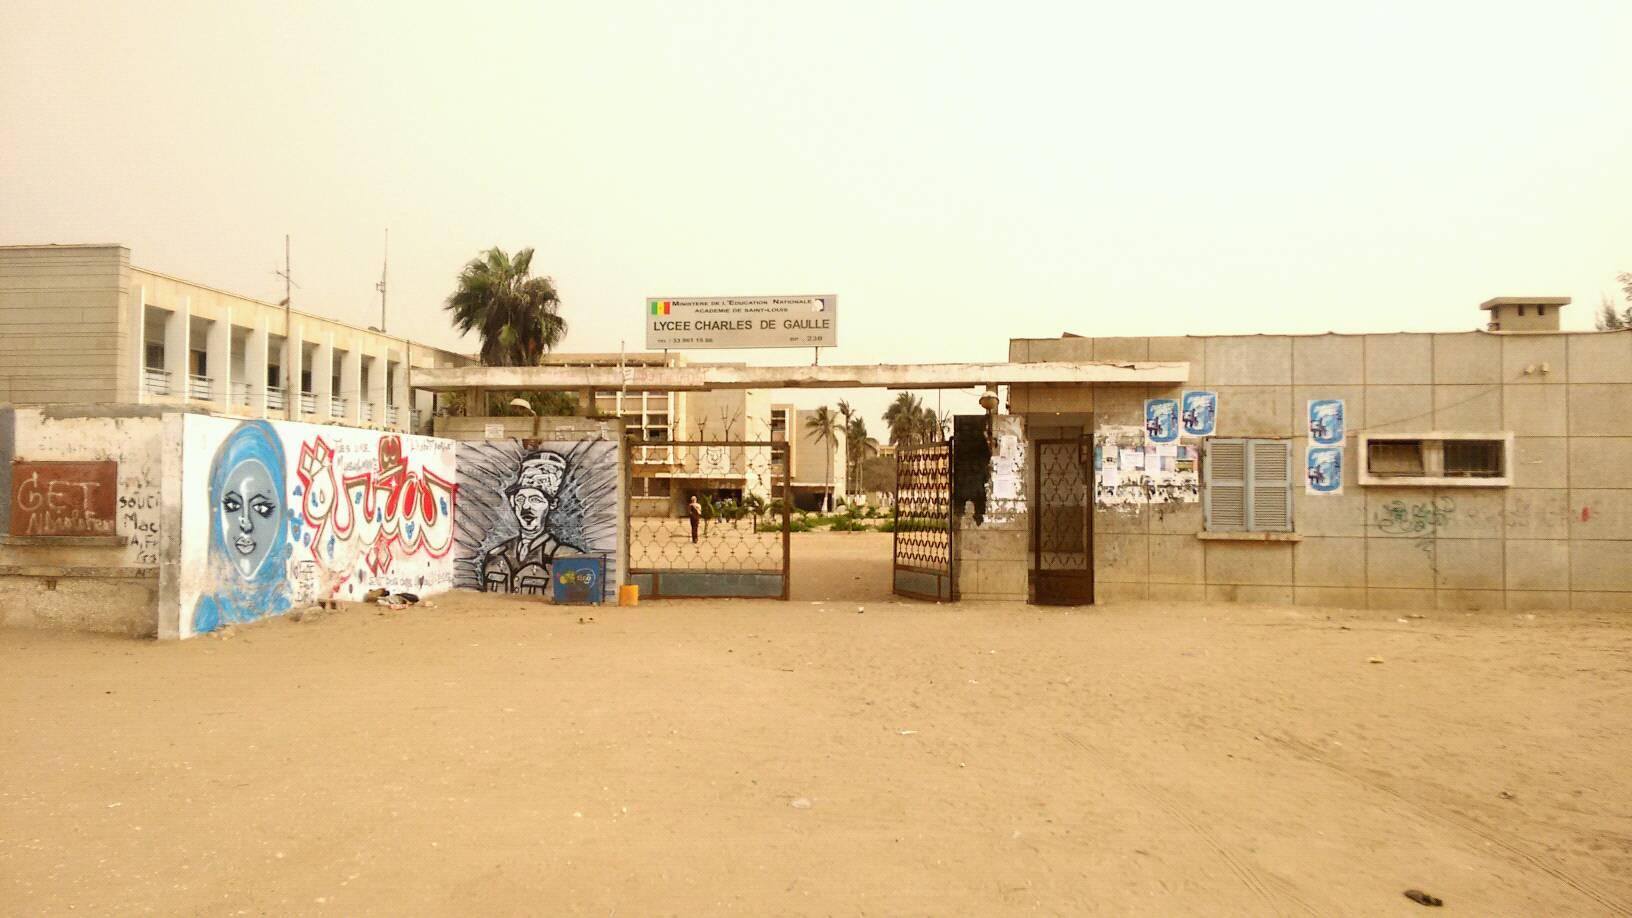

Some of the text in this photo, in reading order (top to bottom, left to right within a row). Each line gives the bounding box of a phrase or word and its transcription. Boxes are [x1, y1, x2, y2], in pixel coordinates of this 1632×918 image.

[653, 319, 830, 331] LYCEE CHARLES DE GAULLE
